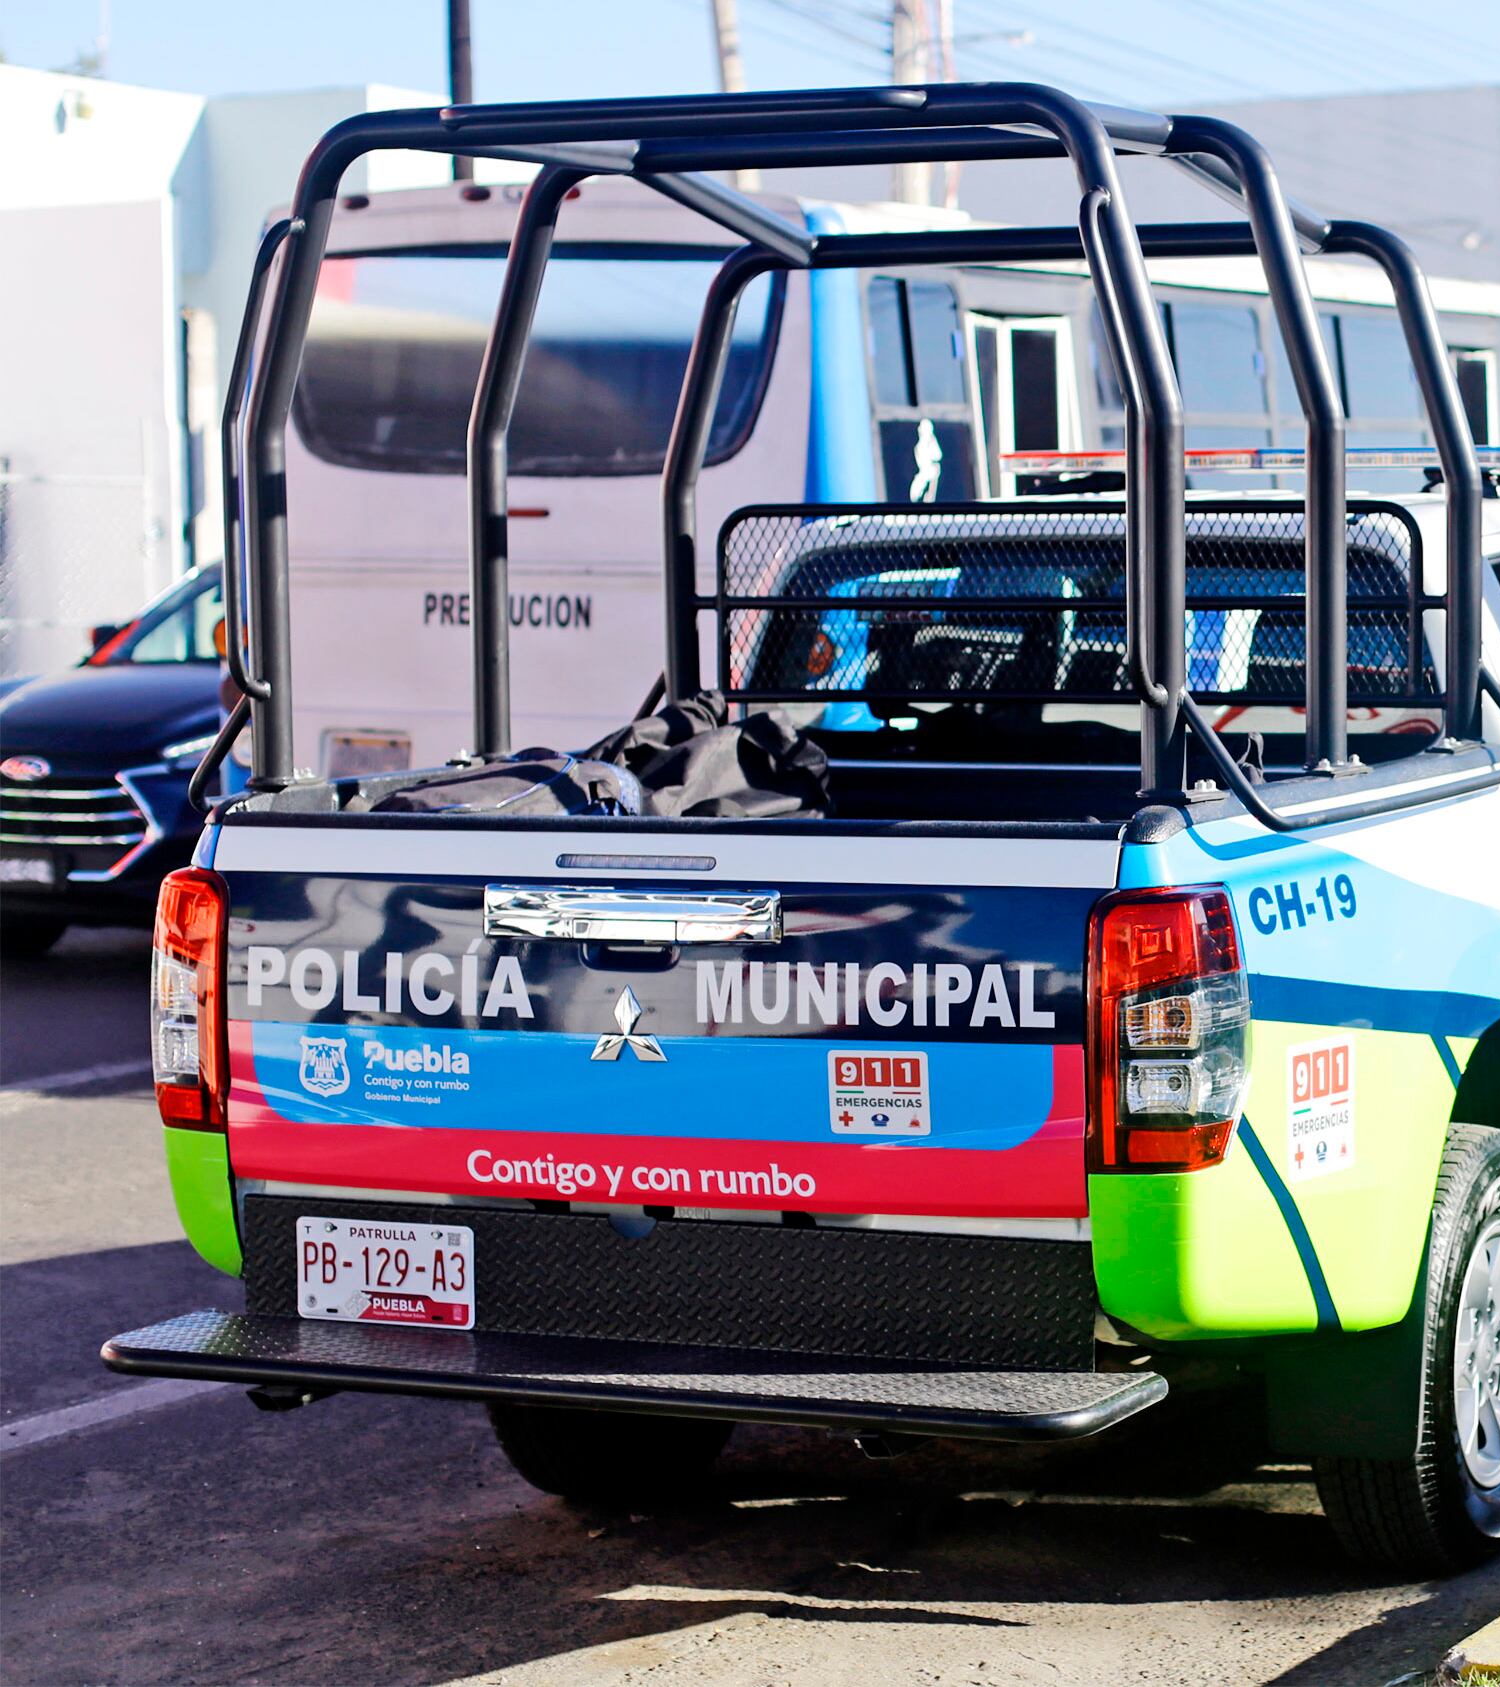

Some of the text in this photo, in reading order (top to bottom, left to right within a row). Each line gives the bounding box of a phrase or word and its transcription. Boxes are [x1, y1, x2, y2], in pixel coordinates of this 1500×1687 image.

[424, 592, 591, 627] PREUCION
[1248, 873, 1357, 935] CH-19
[247, 938, 1056, 1029] POLICÍA MUNICIPAL
[363, 1040, 471, 1074] Puebla
[840, 1061, 912, 1083] 911
[363, 1074, 470, 1091] Contigo y con rumbo
[1295, 1051, 1346, 1097] 911
[364, 1091, 441, 1105] Gobierno Municipal
[836, 1097, 922, 1108] EMERGENCIAS
[1293, 1110, 1349, 1137] EMERGENCIAS
[466, 1149, 816, 1198] Contigo y con rumbo
[304, 1225, 417, 1242] T PATRULLA
[303, 1241, 465, 1292] PB-129-A3
[373, 1298, 426, 1313] PUEBLA
